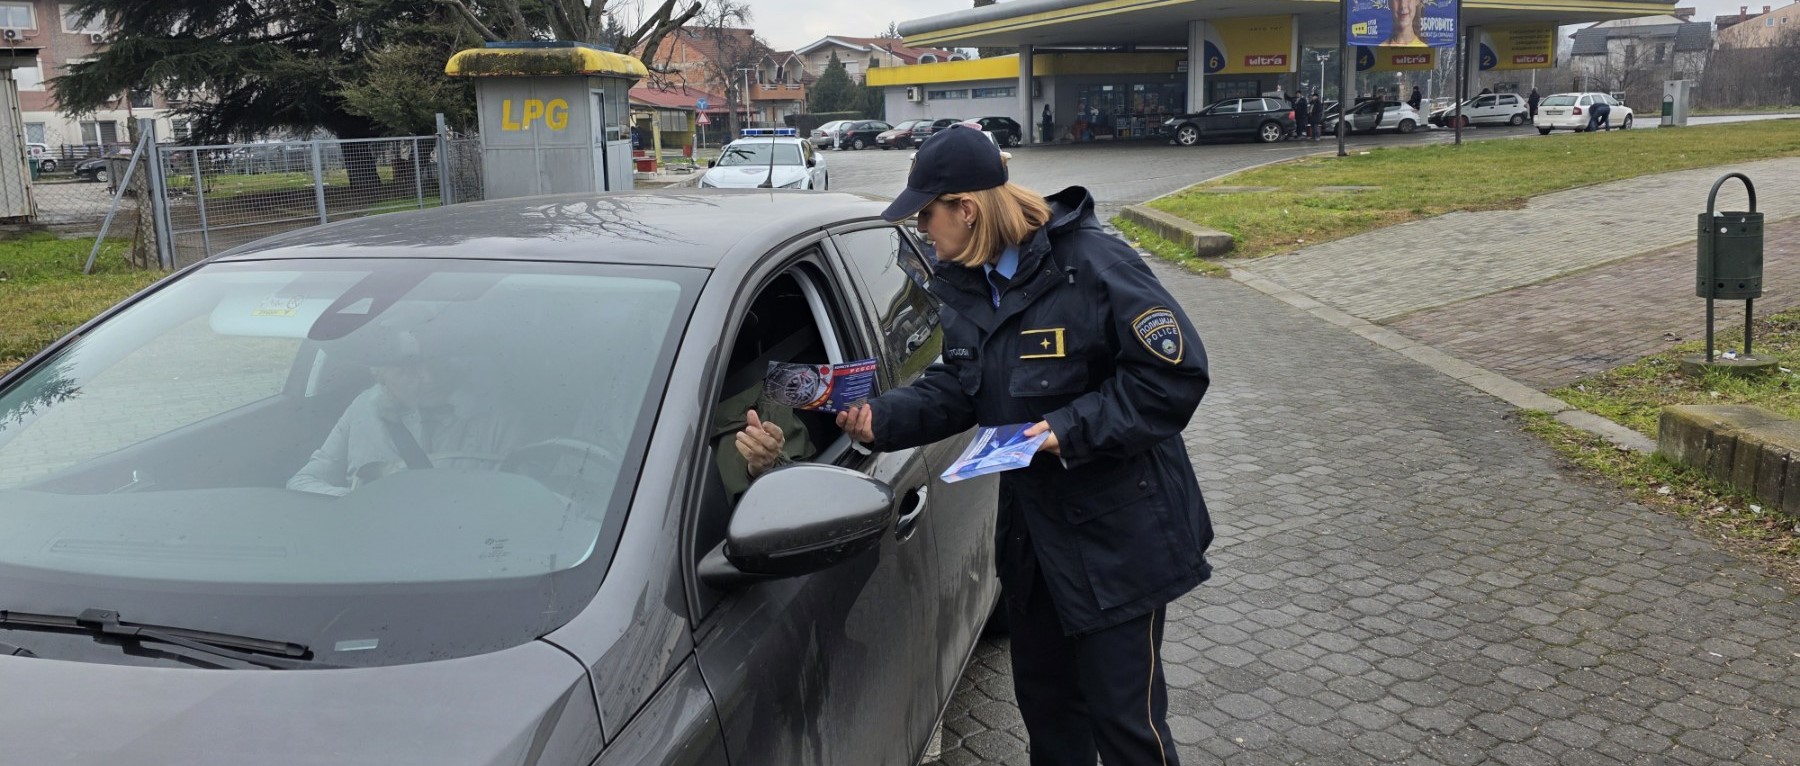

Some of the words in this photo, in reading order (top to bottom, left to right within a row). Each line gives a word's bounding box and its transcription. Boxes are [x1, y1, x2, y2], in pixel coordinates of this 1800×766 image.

[1420, 17, 1454, 31] ЗБОРОВИТЕ
[1209, 56, 1218, 68] 6
[1249, 56, 1282, 65] ultra
[1360, 55, 1368, 65] 4
[1396, 55, 1426, 64] ultra
[1483, 56, 1491, 65] 2
[1516, 55, 1545, 63] ultra
[502, 98, 568, 131] LPG
[1140, 317, 1175, 336] ПОЛИЦИЈА
[1146, 328, 1178, 345] POLICE
